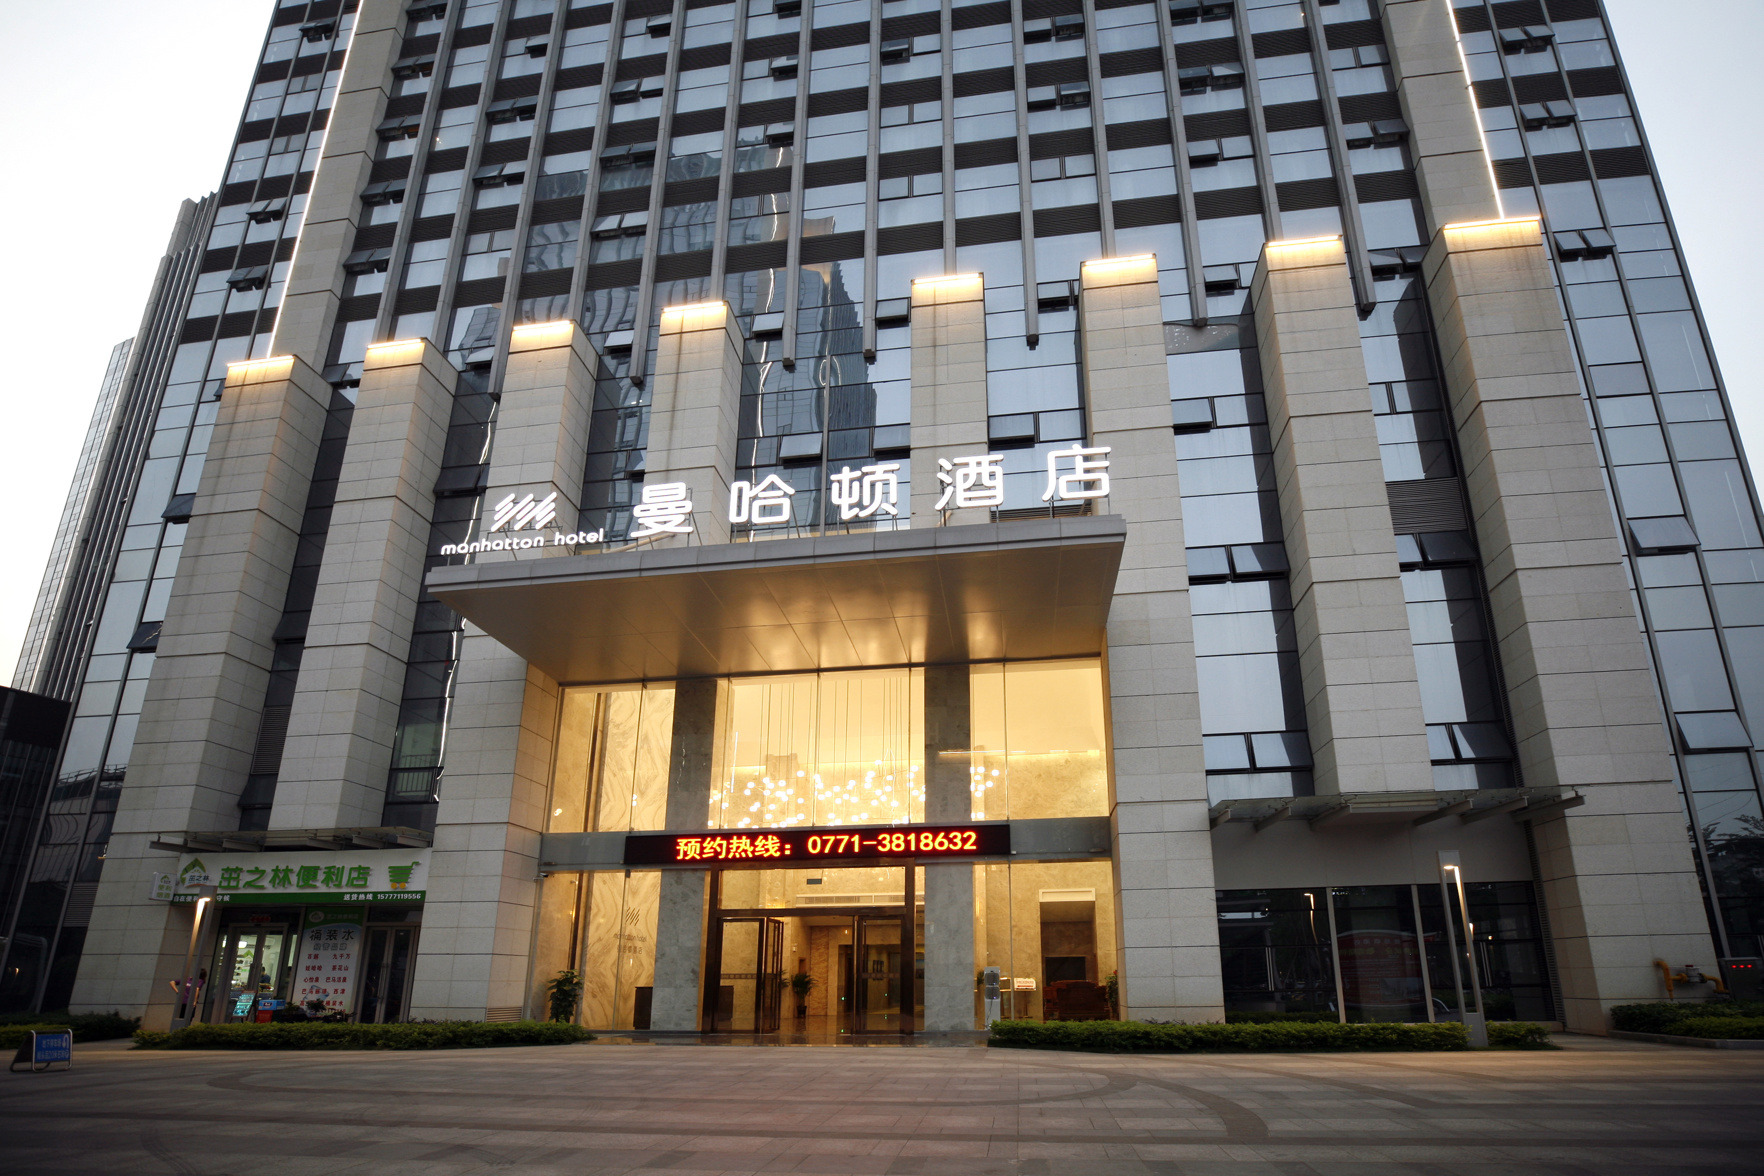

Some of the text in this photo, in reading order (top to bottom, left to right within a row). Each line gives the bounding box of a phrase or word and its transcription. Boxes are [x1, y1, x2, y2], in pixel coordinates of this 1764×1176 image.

[630, 444, 1112, 536] 曼哈顿酒店
[440, 528, 604, 555] manhatton hotel
[218, 865, 371, 888] 茁之林便利店
[343, 893, 373, 901] 送货热线
[309, 928, 354, 941] 桶装水
